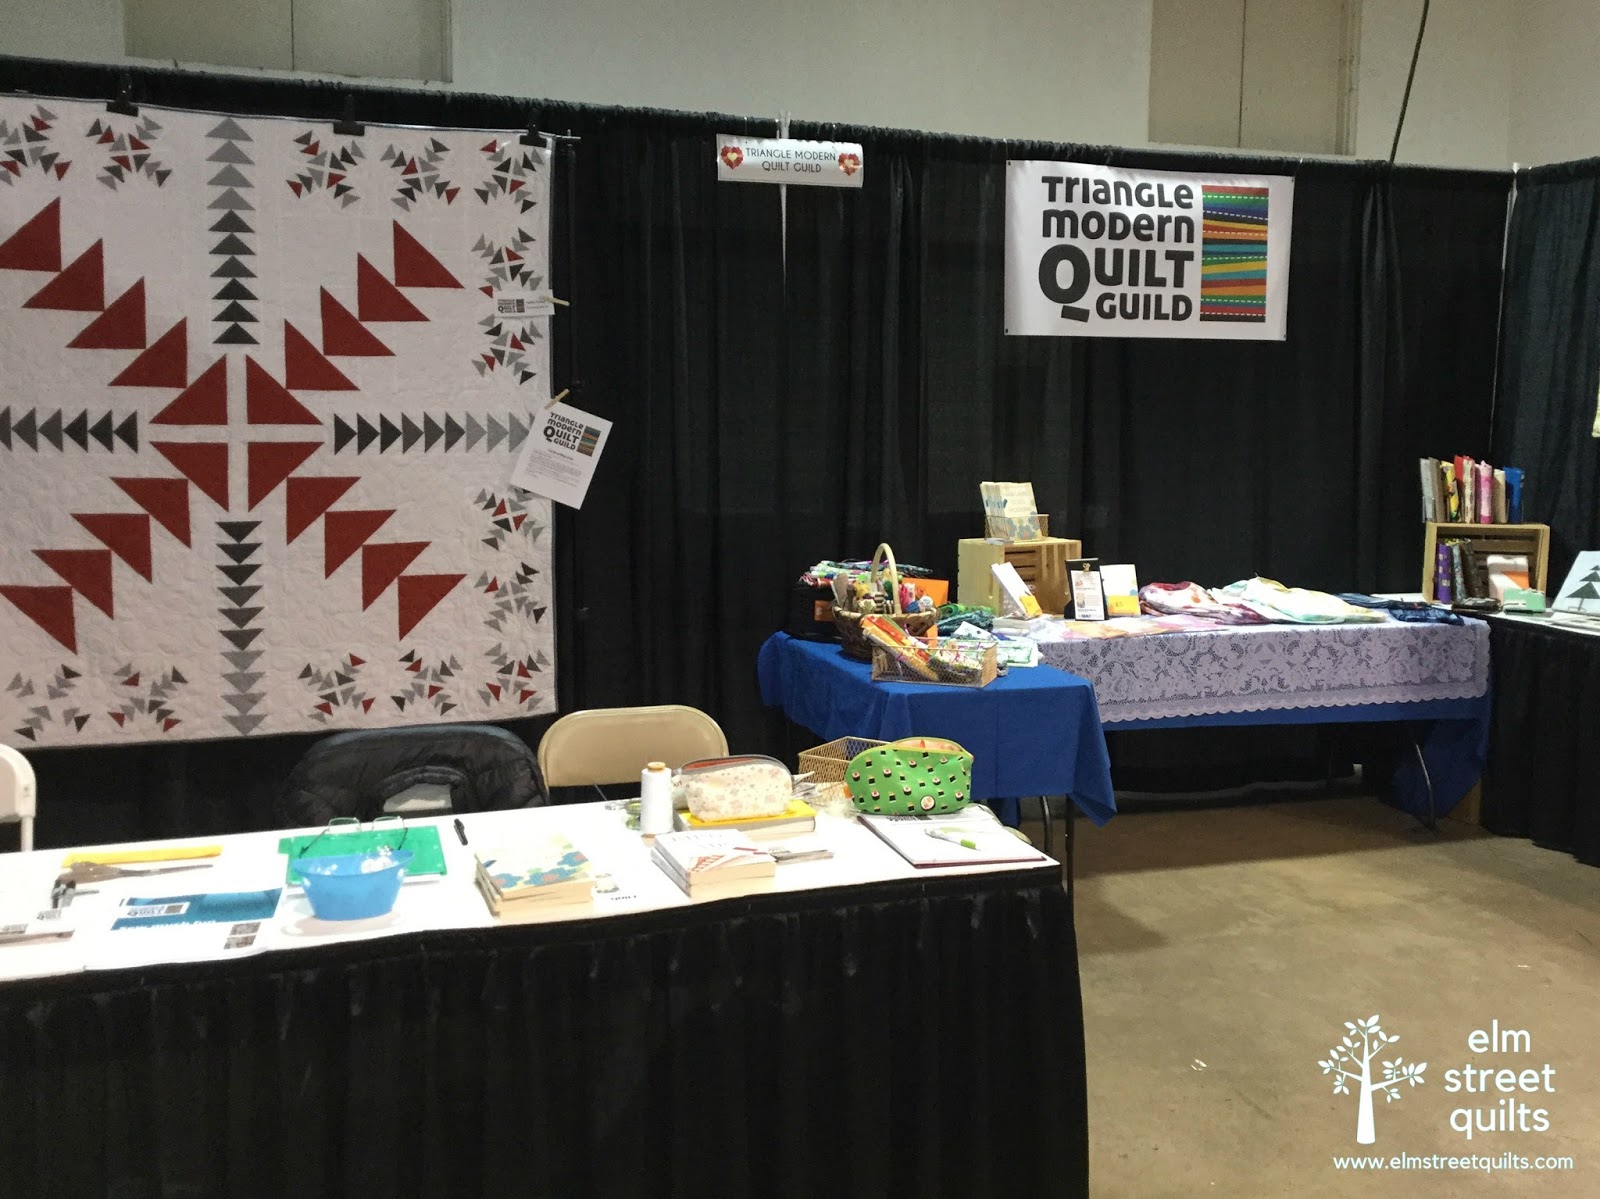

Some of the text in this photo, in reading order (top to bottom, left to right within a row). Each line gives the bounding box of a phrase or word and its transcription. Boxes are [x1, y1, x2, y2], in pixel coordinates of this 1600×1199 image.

[745, 147, 836, 161] TRIANGLE MODERN
[761, 160, 822, 173] QUILT GUILD
[1038, 243, 1195, 323] QUILT
[1095, 292, 1193, 322] GUILD
[543, 425, 580, 444] QUILT
[553, 437, 576, 451] GUILD
